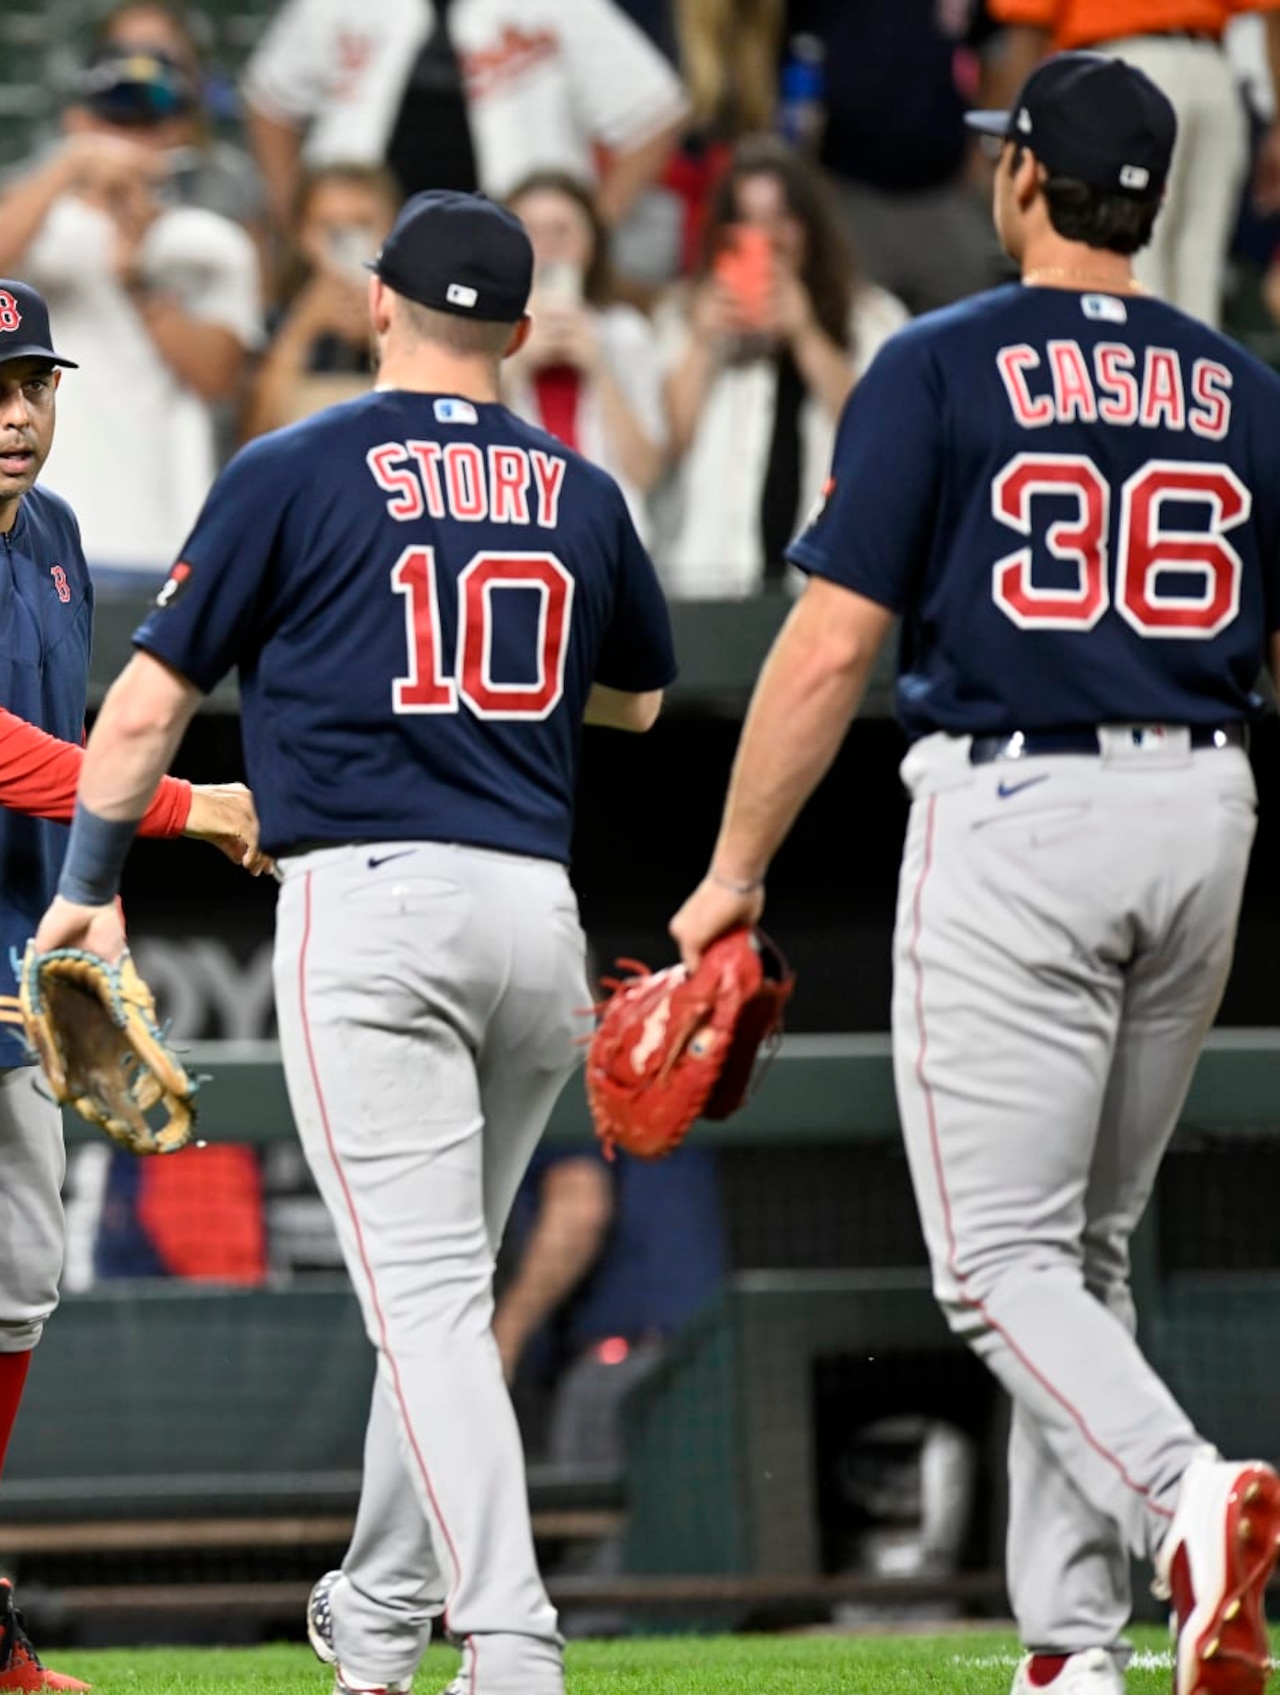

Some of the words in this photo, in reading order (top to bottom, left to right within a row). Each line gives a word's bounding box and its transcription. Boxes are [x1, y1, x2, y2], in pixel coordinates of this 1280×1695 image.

[996, 339, 1233, 441] CASAS
[366, 439, 567, 529] STORY
[991, 451, 1252, 640] 36
[390, 545, 576, 721] 10
